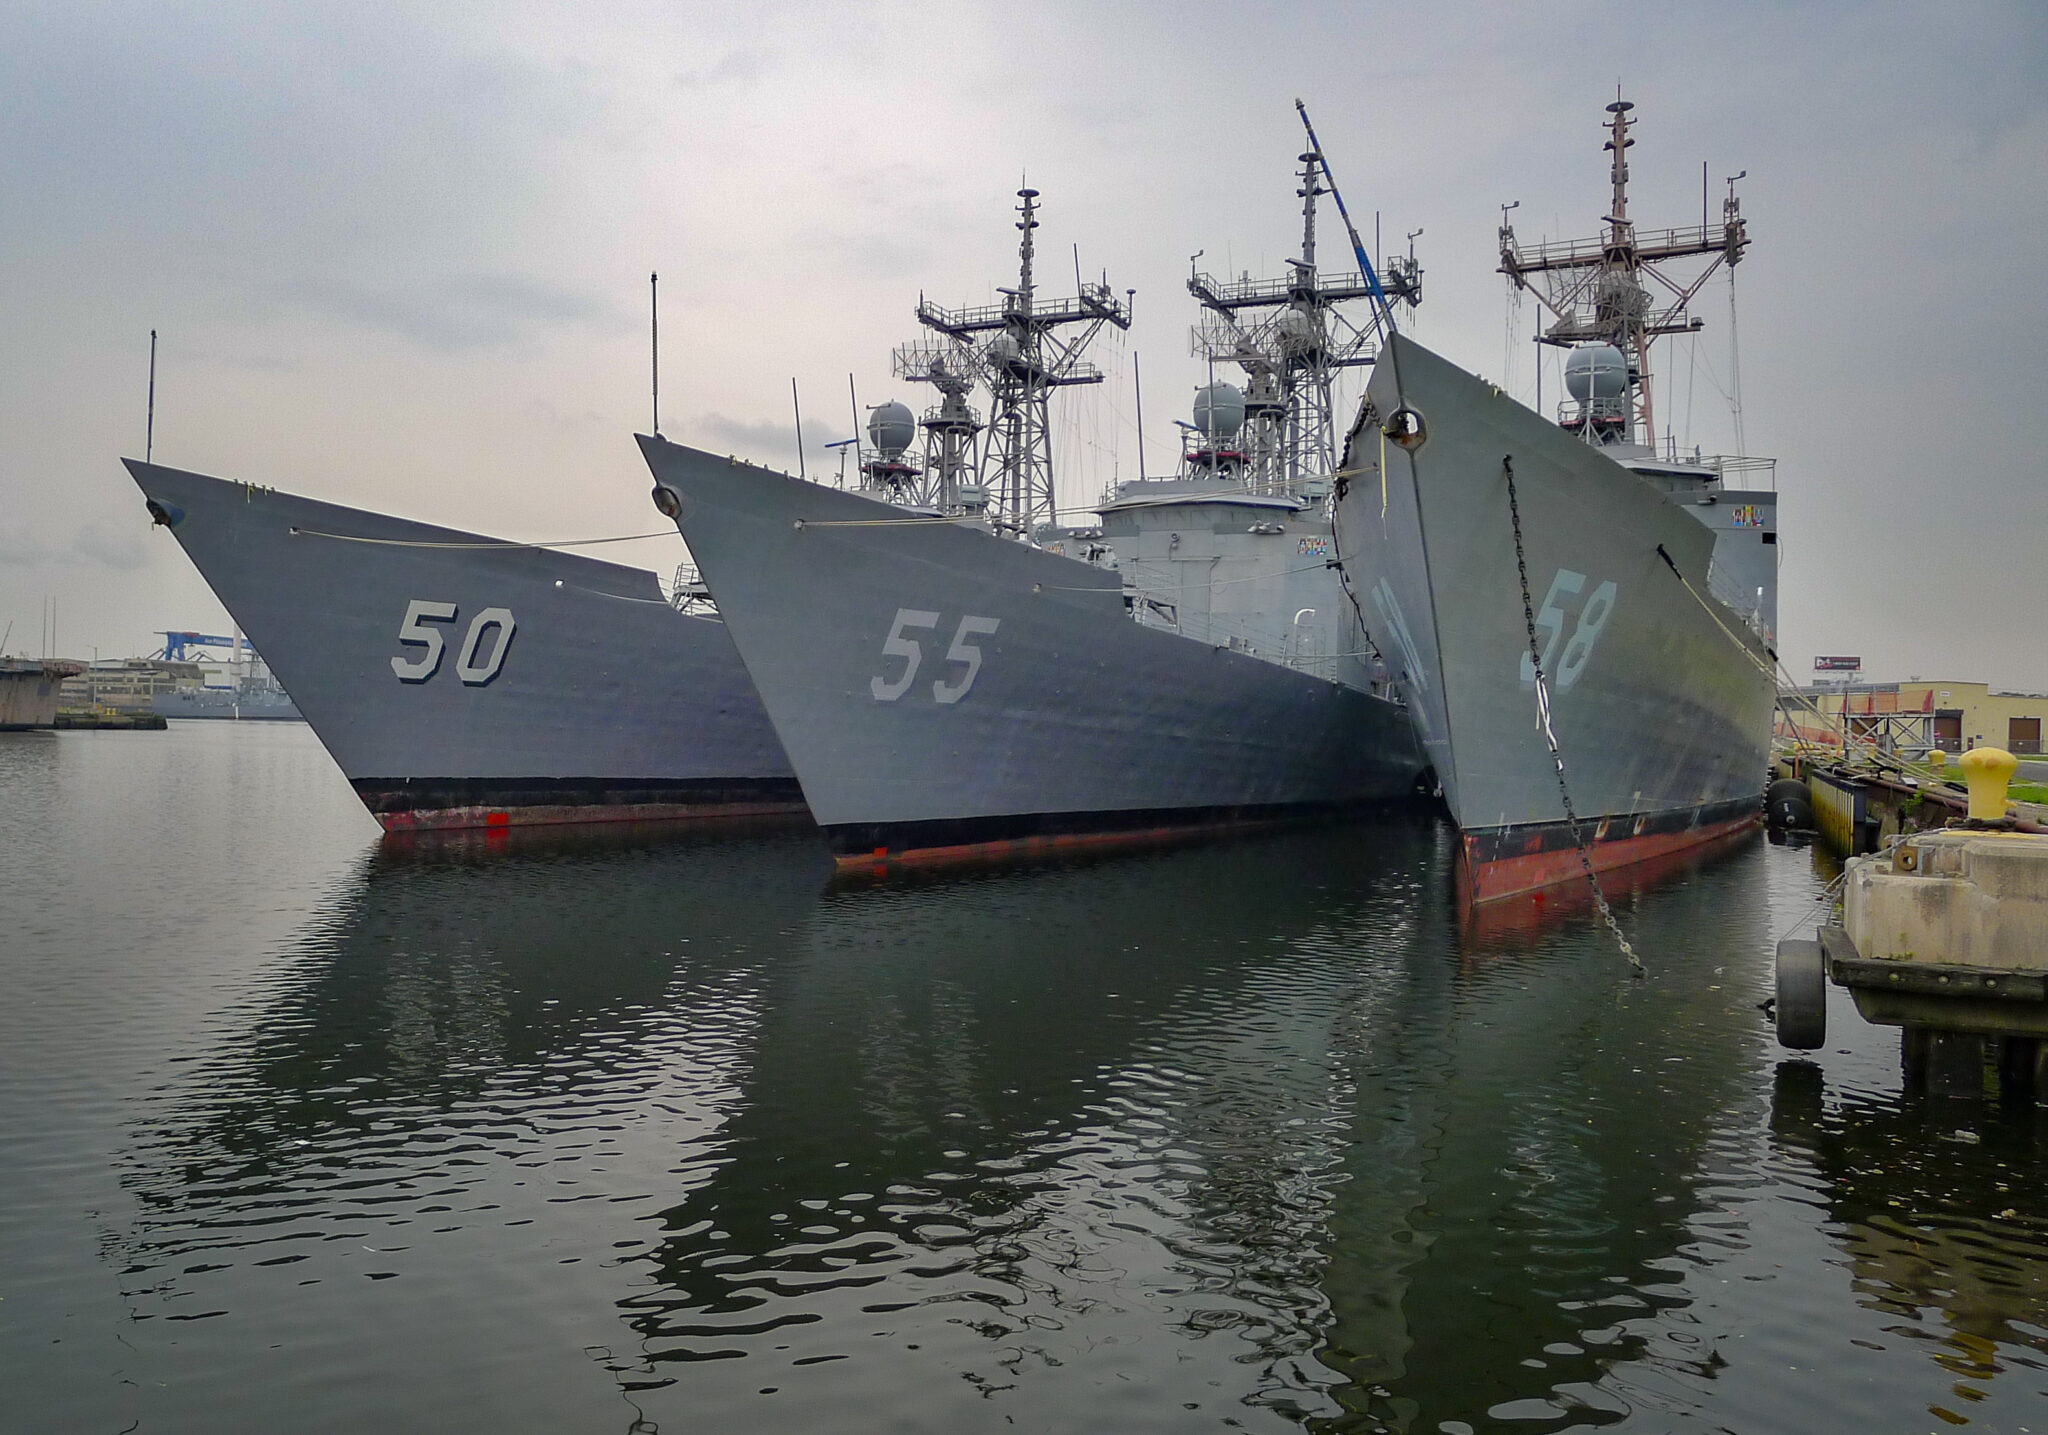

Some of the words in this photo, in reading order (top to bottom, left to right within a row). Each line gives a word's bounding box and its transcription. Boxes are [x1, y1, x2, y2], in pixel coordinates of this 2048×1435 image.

[391, 599, 518, 687] 50
[870, 608, 1001, 704] 55
[1520, 568, 1617, 688] 58
